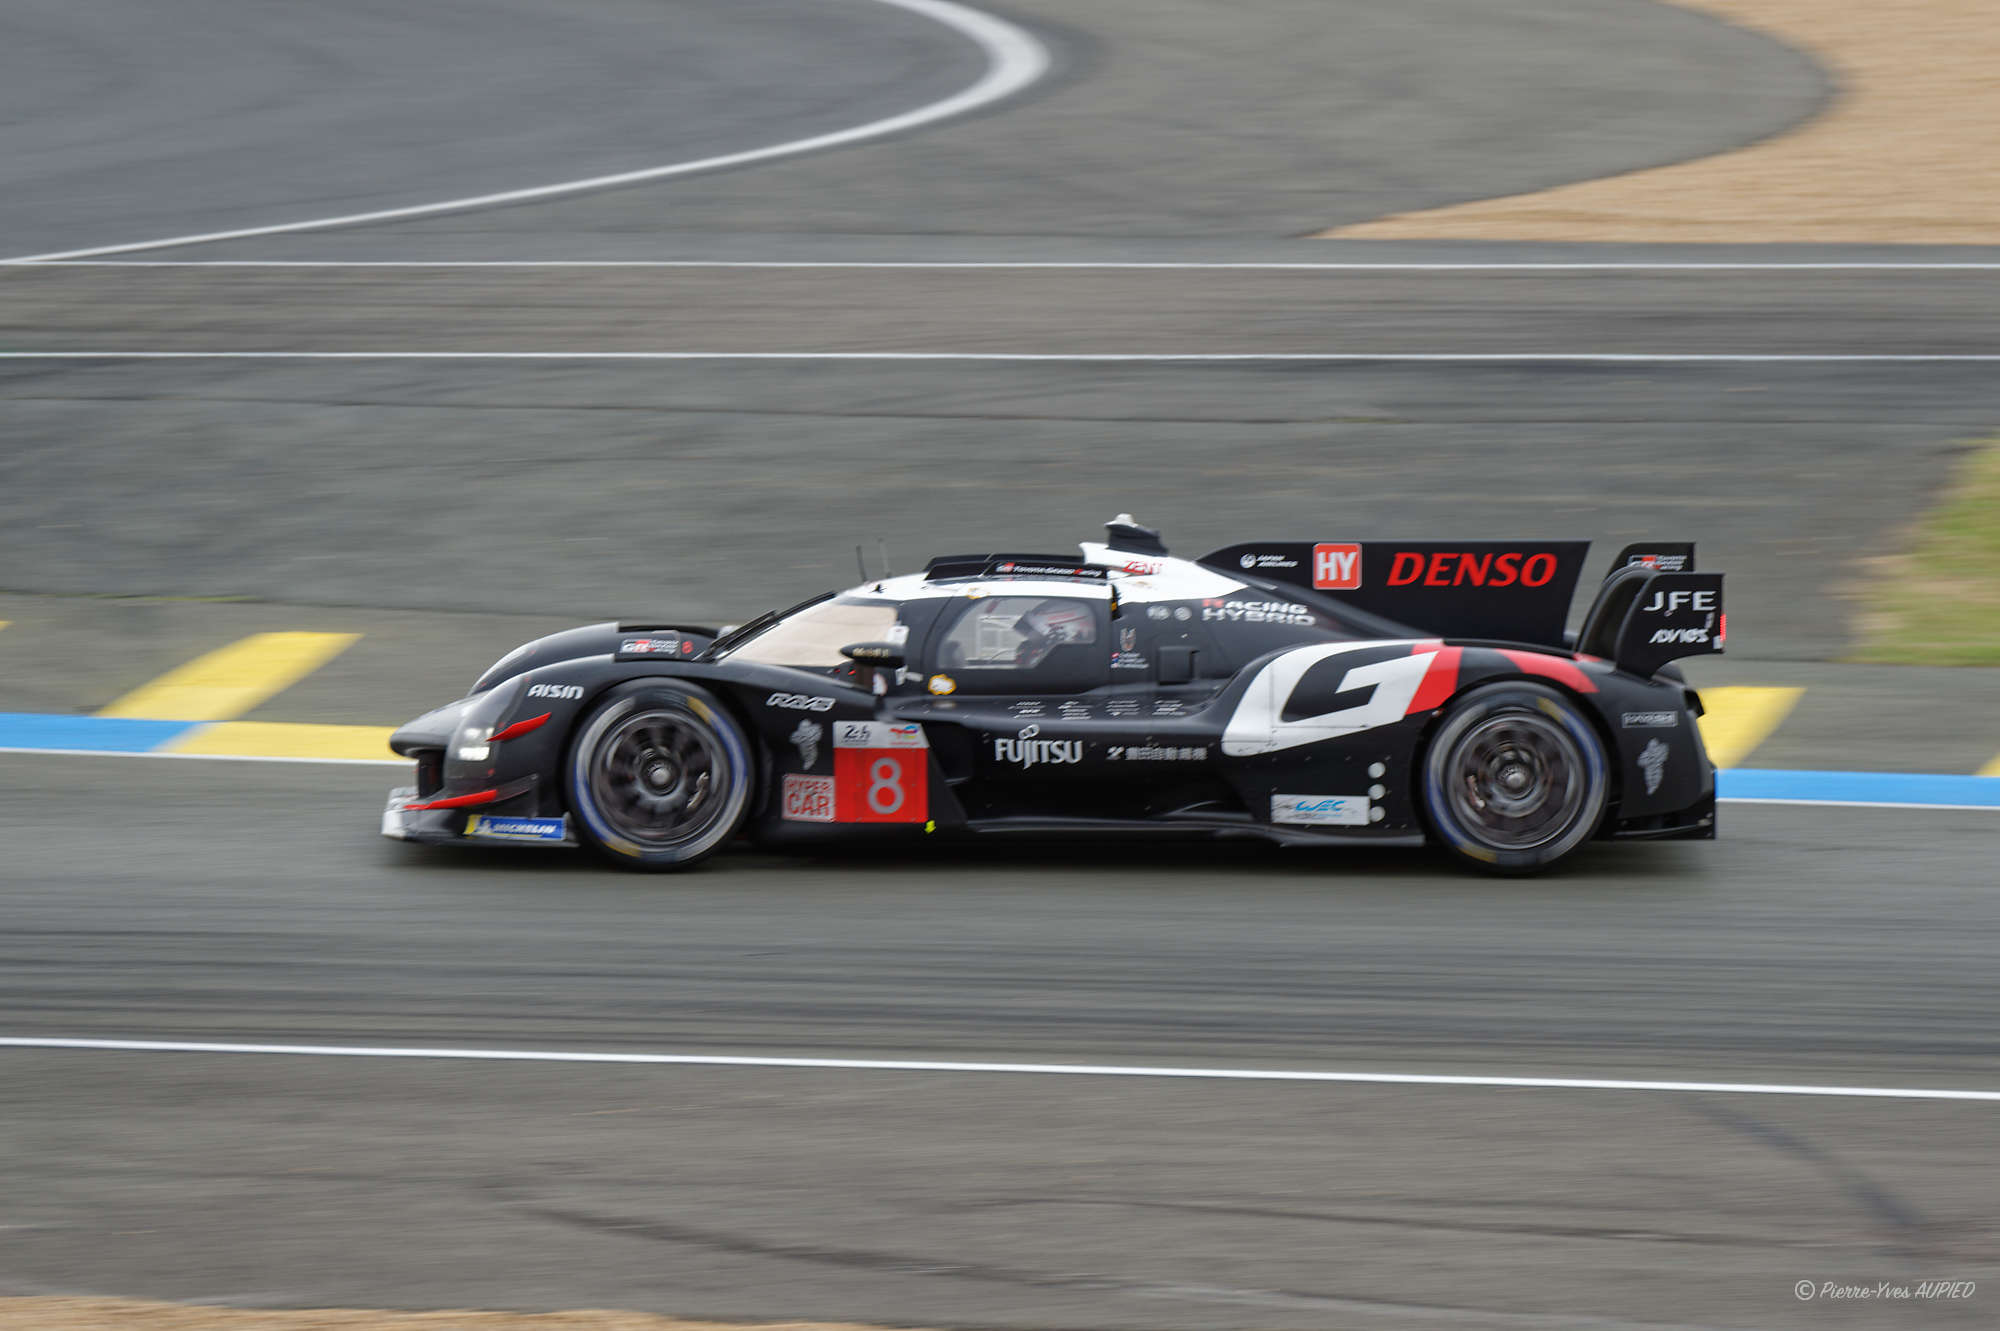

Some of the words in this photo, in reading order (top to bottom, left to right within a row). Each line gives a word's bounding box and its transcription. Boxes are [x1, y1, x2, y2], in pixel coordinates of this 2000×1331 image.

[1316, 552, 1356, 581] HY
[1386, 552, 1557, 587] DENSO
[1202, 599, 1308, 615] RACING
[1643, 591, 1716, 611] JFE
[1202, 607, 1316, 626] HYBRID
[681, 640, 694, 654] 8
[528, 683, 585, 700] AISIN
[994, 737, 1083, 770] FUJITSU
[867, 757, 905, 815] 8
[787, 793, 831, 817] CAR
